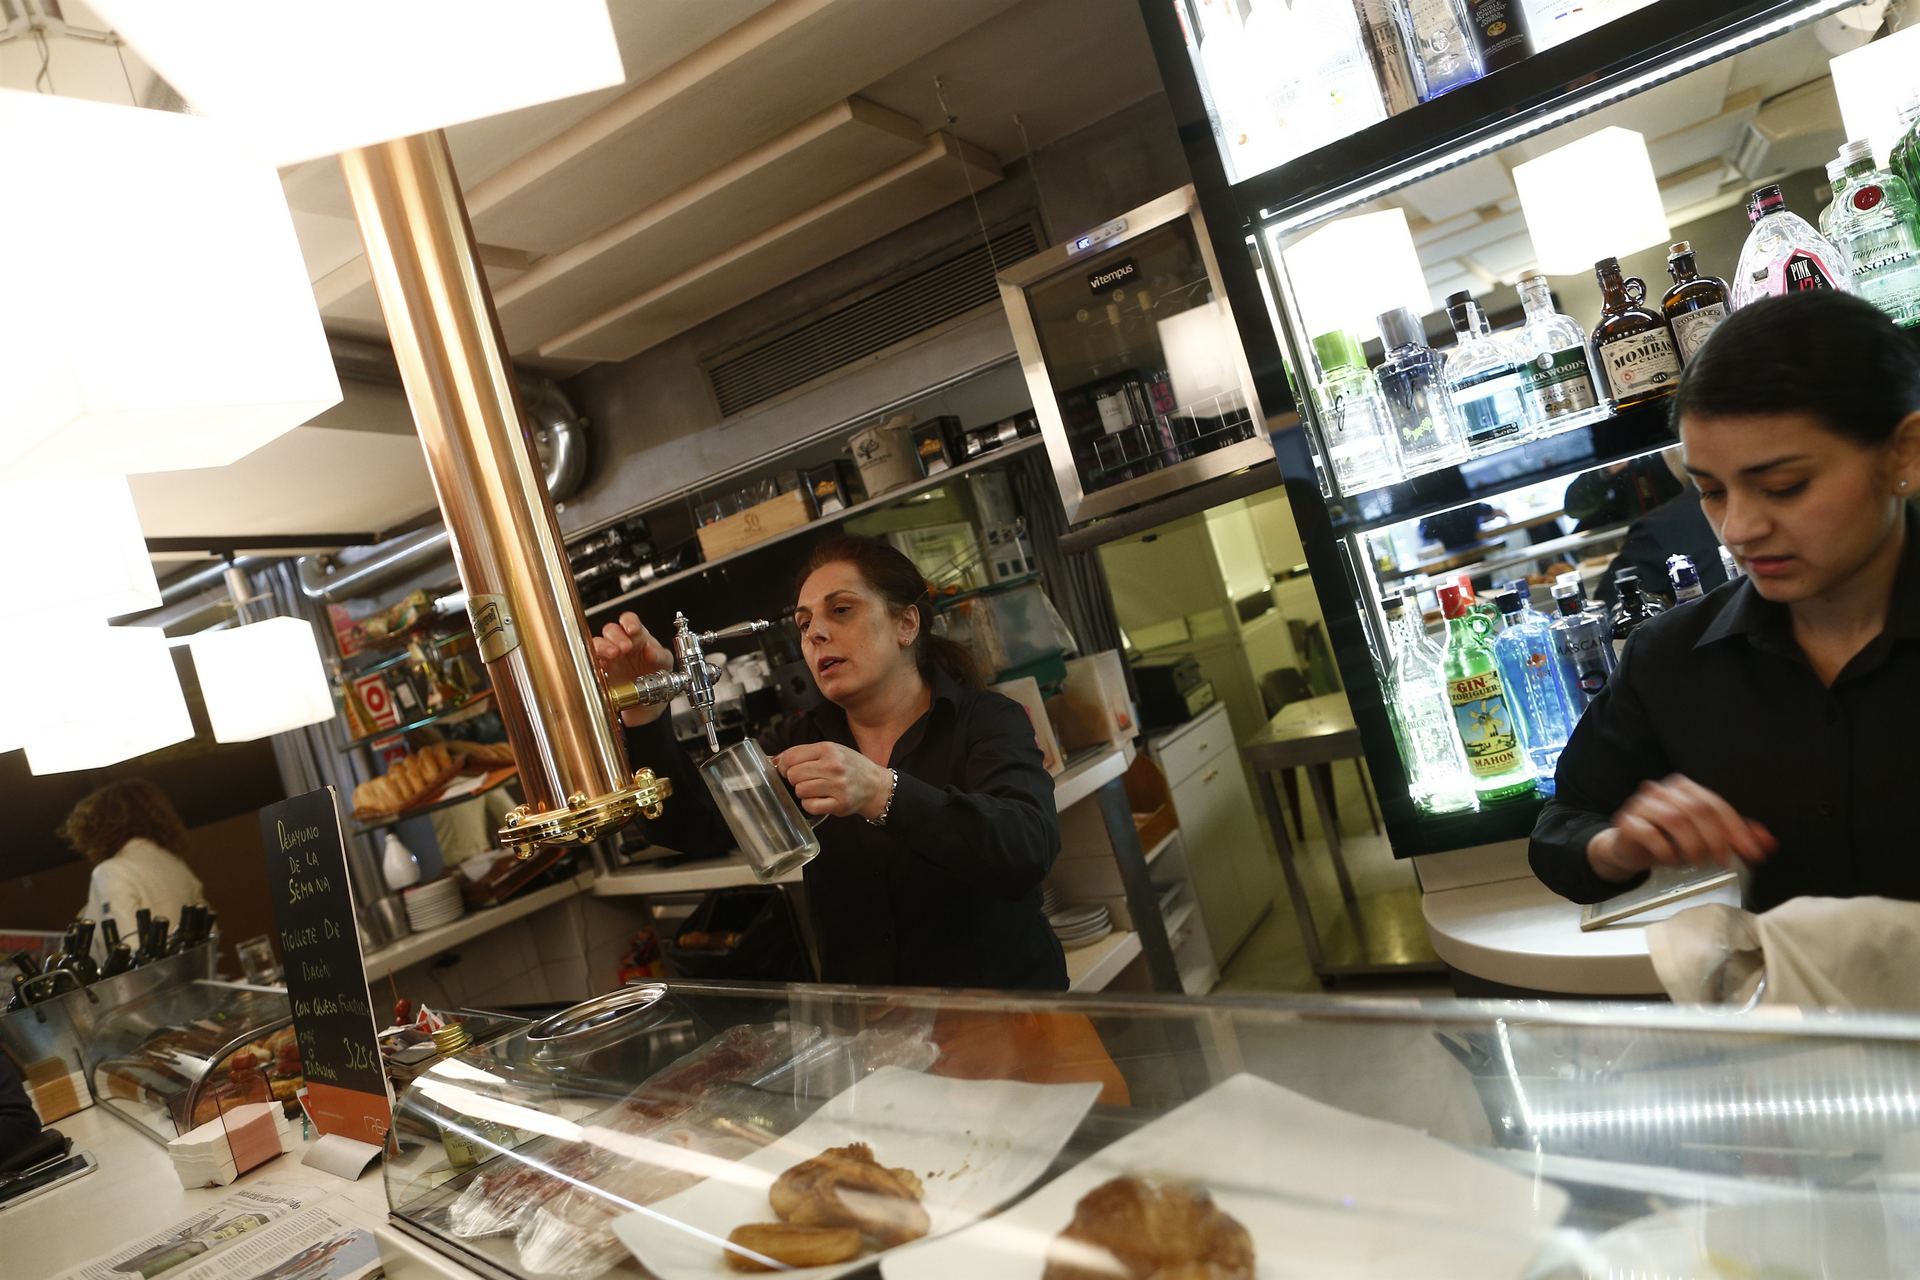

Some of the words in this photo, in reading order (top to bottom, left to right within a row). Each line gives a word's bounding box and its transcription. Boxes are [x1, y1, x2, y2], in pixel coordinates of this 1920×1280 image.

[1852, 240, 1900, 261] Tanqueray
[1790, 259, 1811, 281] PINK
[1851, 252, 1910, 277] RANGPUR
[1090, 264, 1134, 289] vitempus
[1677, 309, 1709, 329] MONKEY
[1639, 352, 1666, 363] CLUB
[1652, 372, 1668, 383] GIN
[1568, 384, 1587, 394] GIN
[1456, 677, 1486, 693] GIN
[1474, 751, 1515, 768] MAHON
[277, 819, 320, 854] DESAYUNO
[288, 856, 301, 874] DE
[306, 851, 320, 867] LA
[288, 875, 331, 904] SEMANA
